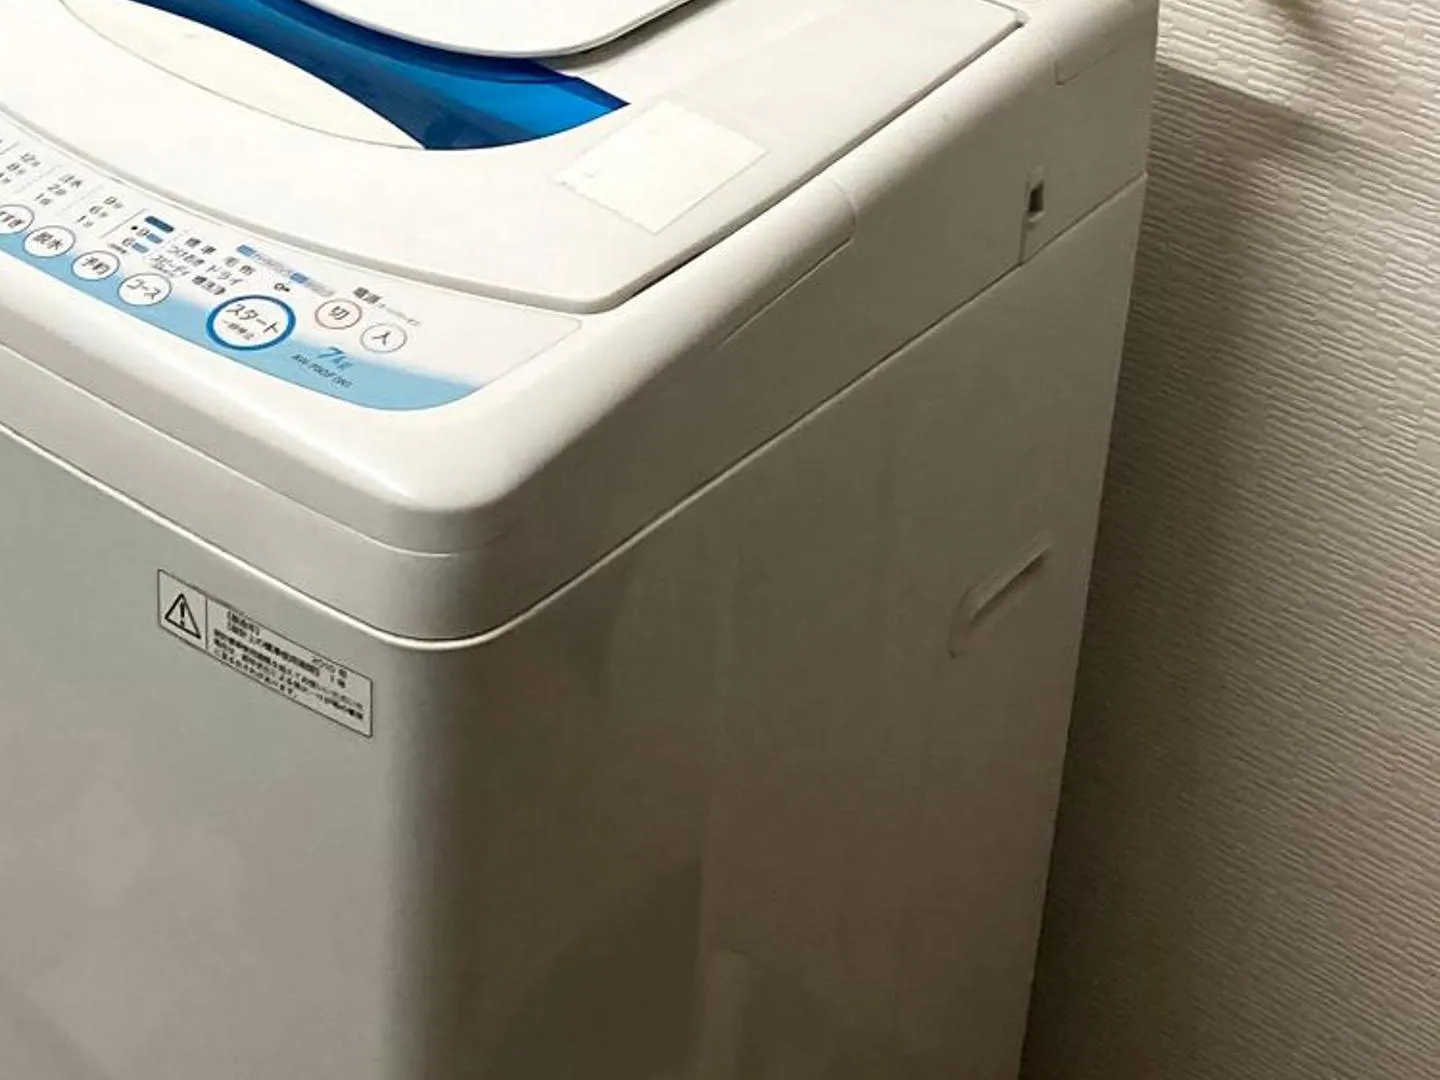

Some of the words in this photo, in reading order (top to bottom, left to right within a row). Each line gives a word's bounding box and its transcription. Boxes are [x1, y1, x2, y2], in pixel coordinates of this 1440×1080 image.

[32, 231, 64, 251] 脱水
[126, 278, 161, 301] コース
[225, 303, 280, 334] スタート
[328, 305, 350, 321] 切
[372, 331, 392, 346] 入
